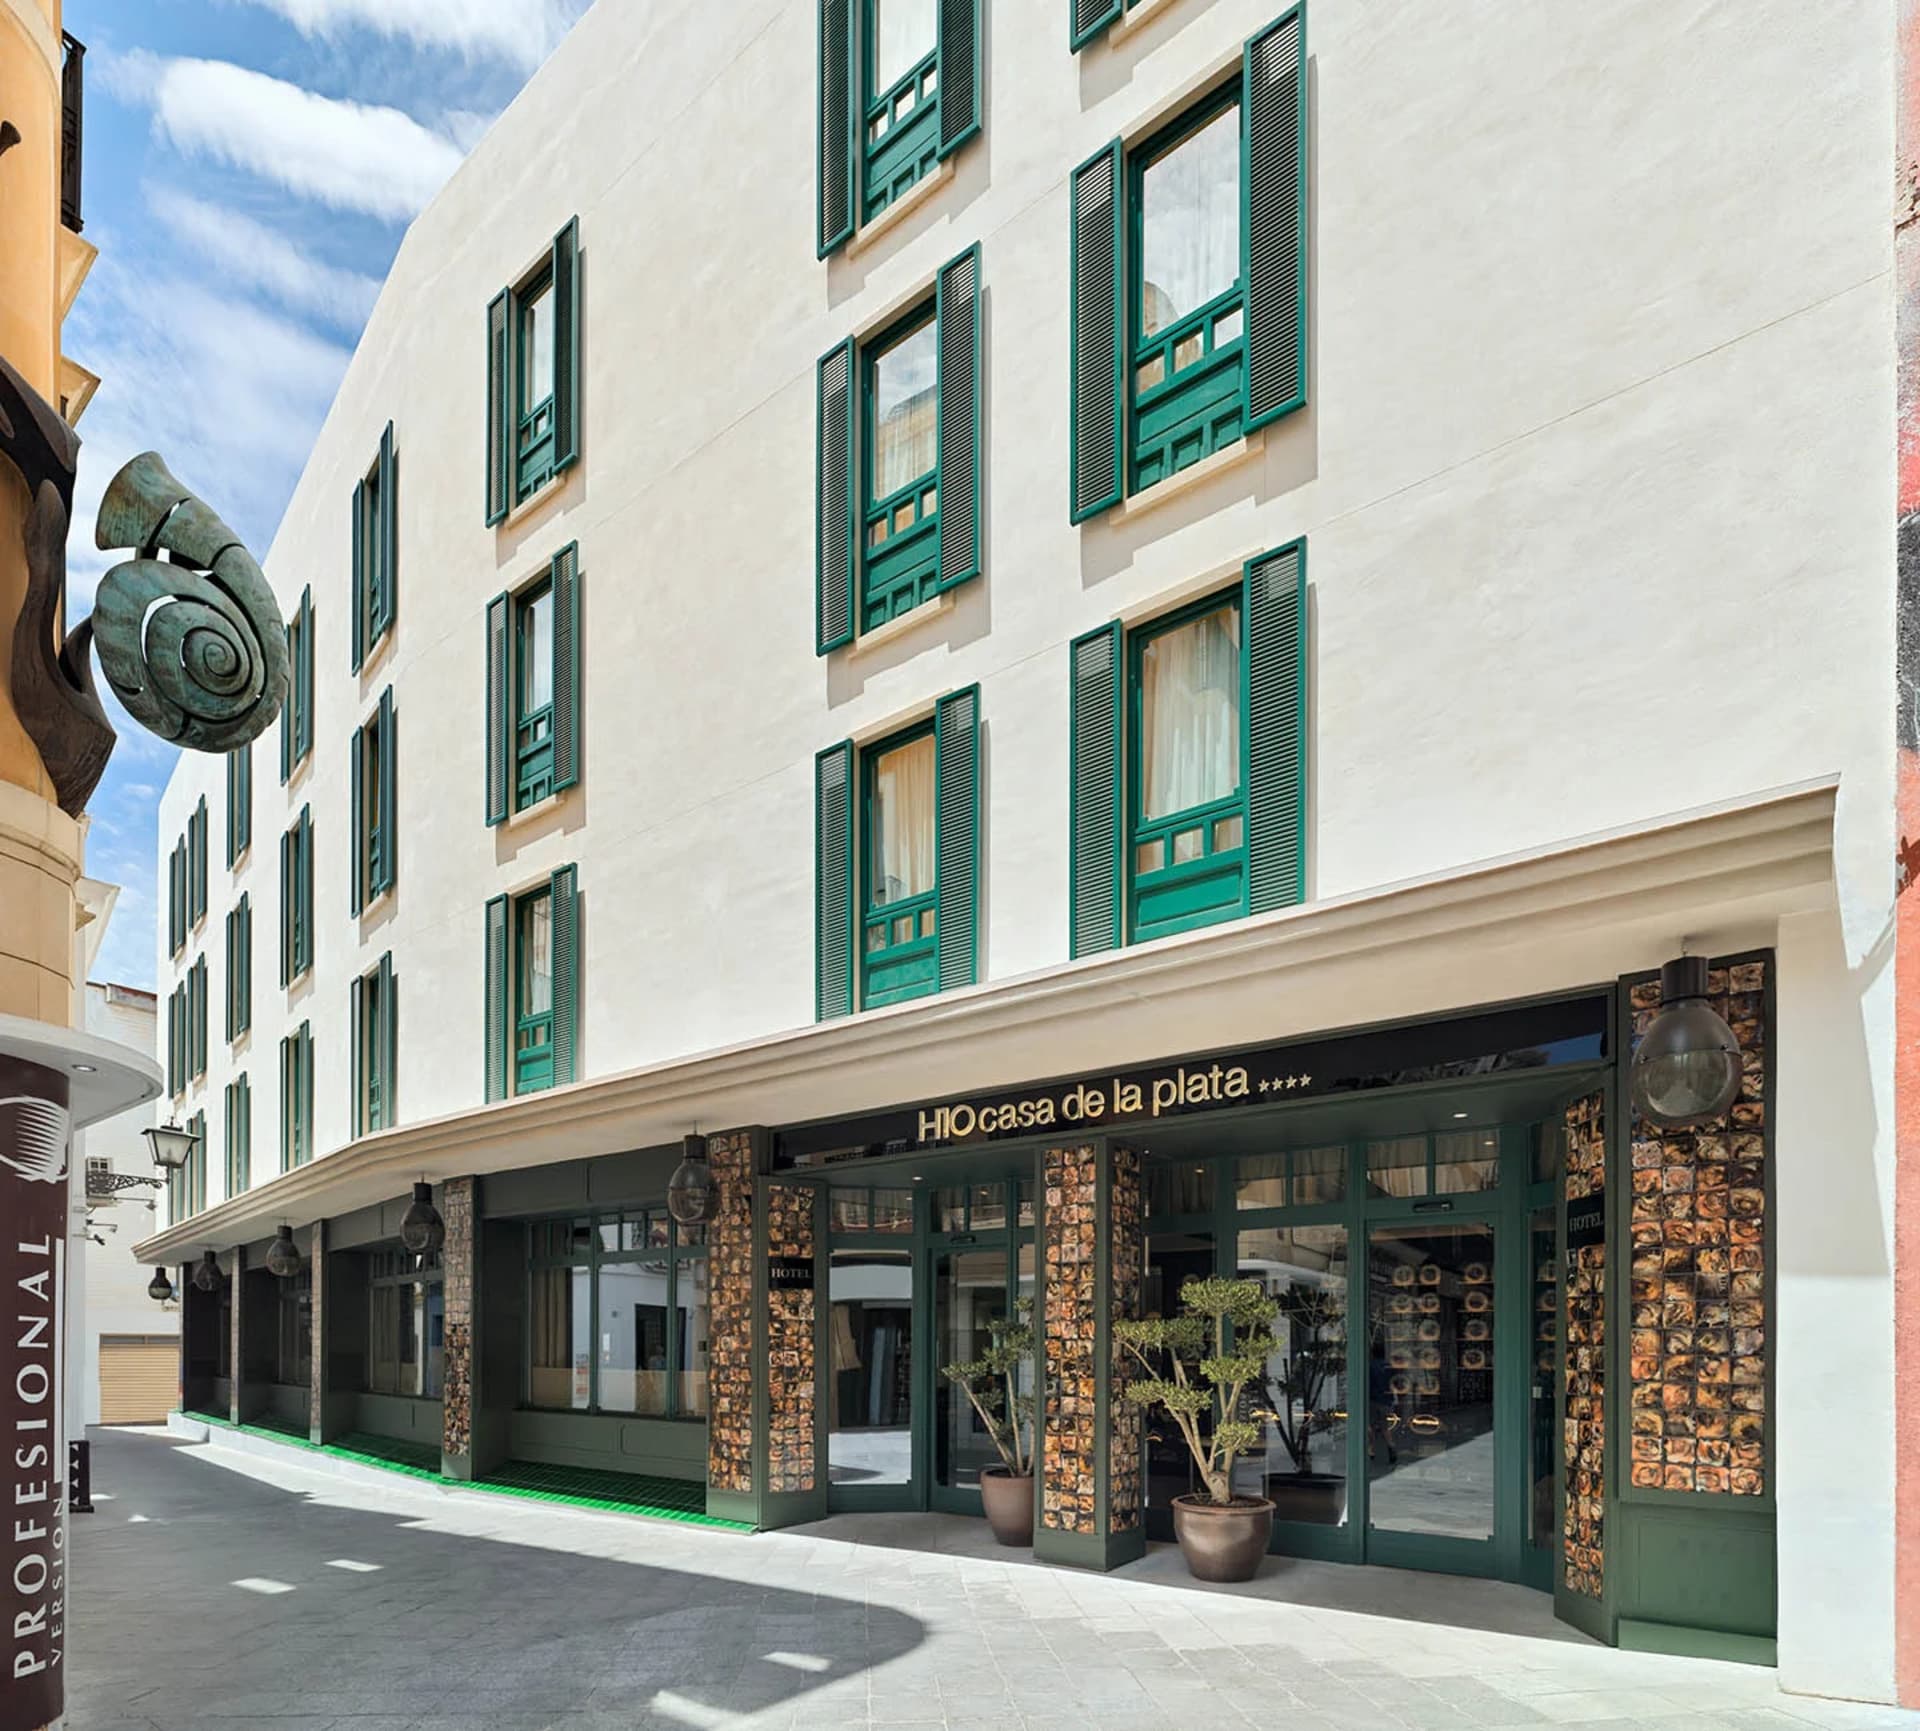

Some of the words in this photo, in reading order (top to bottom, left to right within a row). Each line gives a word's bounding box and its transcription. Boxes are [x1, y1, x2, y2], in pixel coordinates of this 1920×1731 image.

[978, 1098, 1056, 1132] casa
[1061, 1084, 1105, 1120] de
[1113, 1078, 1143, 1114] la
[1152, 1064, 1250, 1117] plata
[1569, 1212, 1604, 1232] HOTEL
[771, 1267, 811, 1278] HOTEL
[14, 1234, 50, 1679] PROFESIONAL
[51, 1498, 64, 1667] VERSION
